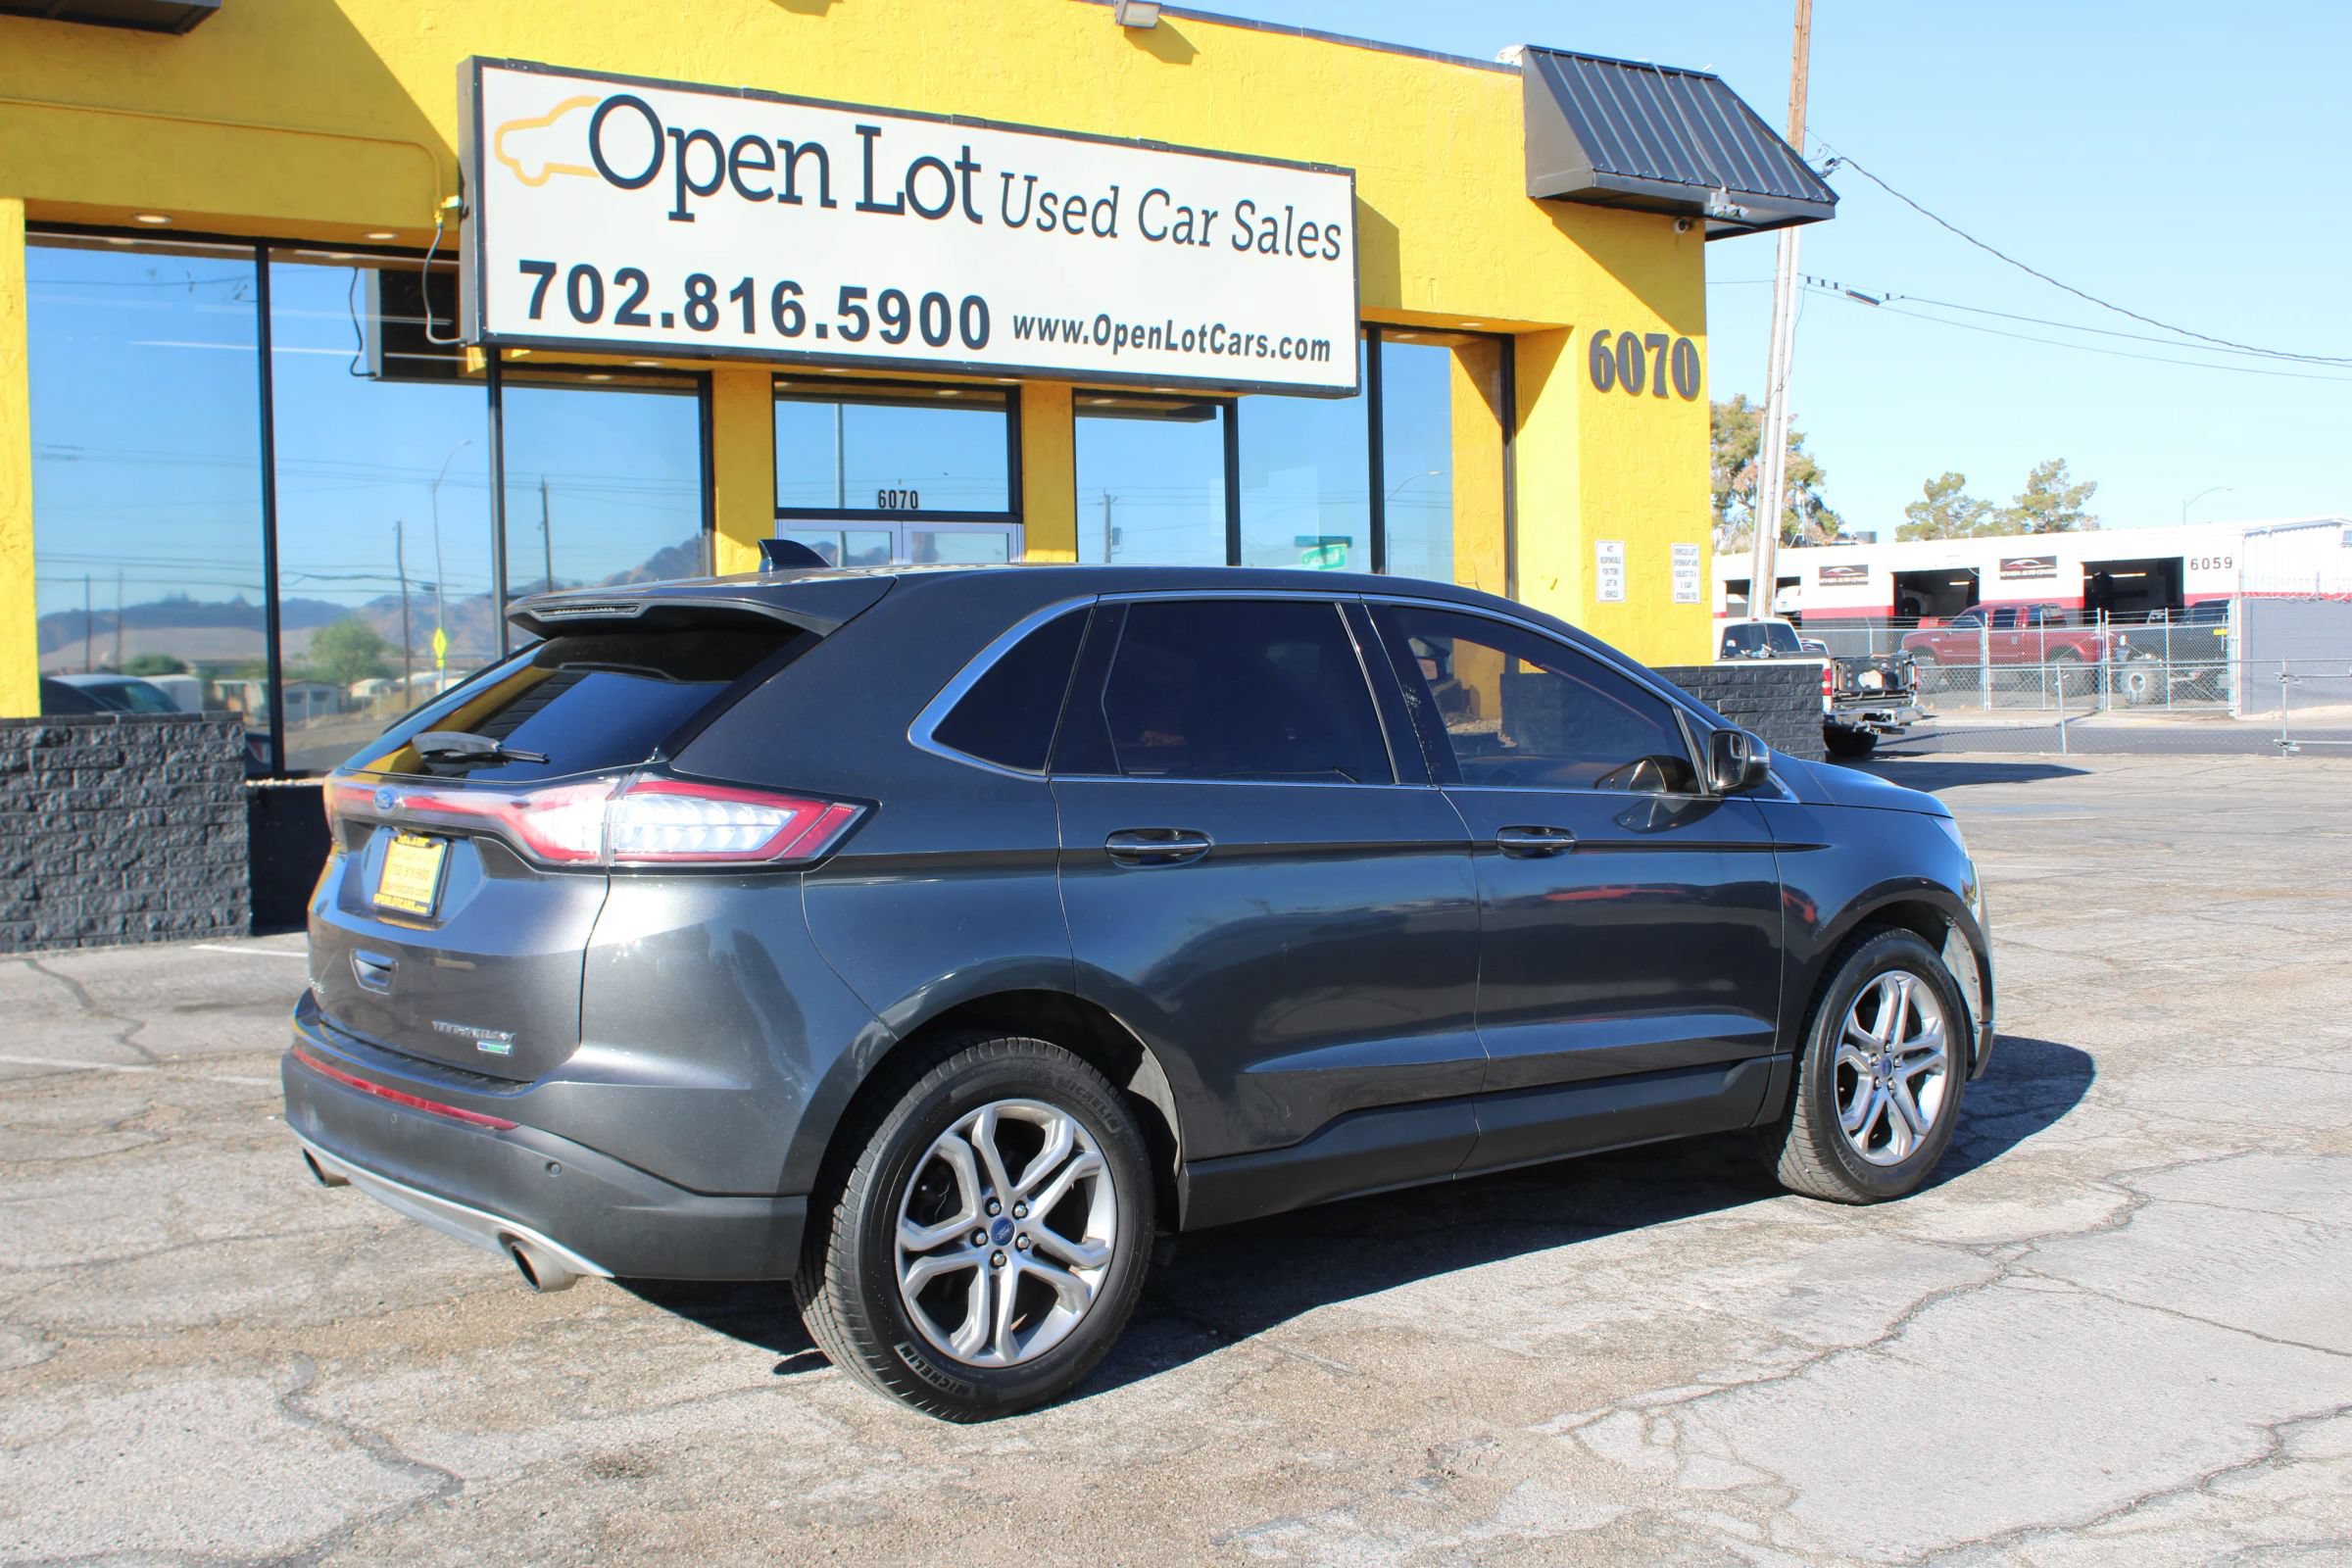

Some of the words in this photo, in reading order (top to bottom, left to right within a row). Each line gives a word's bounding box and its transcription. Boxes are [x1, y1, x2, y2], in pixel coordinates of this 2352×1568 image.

[589, 94, 837, 222] Open
[856, 123, 983, 224] Lot
[1001, 172, 1119, 238] Used
[1138, 187, 1218, 247] Car
[1231, 199, 1342, 261] Sales
[519, 259, 991, 350] 702.816.5900
[1013, 314, 1331, 363] www.OpenLotCars.com
[1589, 329, 1700, 402] 6070
[878, 489, 918, 510] 6070
[2190, 557, 2232, 570] 6059
[900, 1345, 971, 1396] MICHELIN
